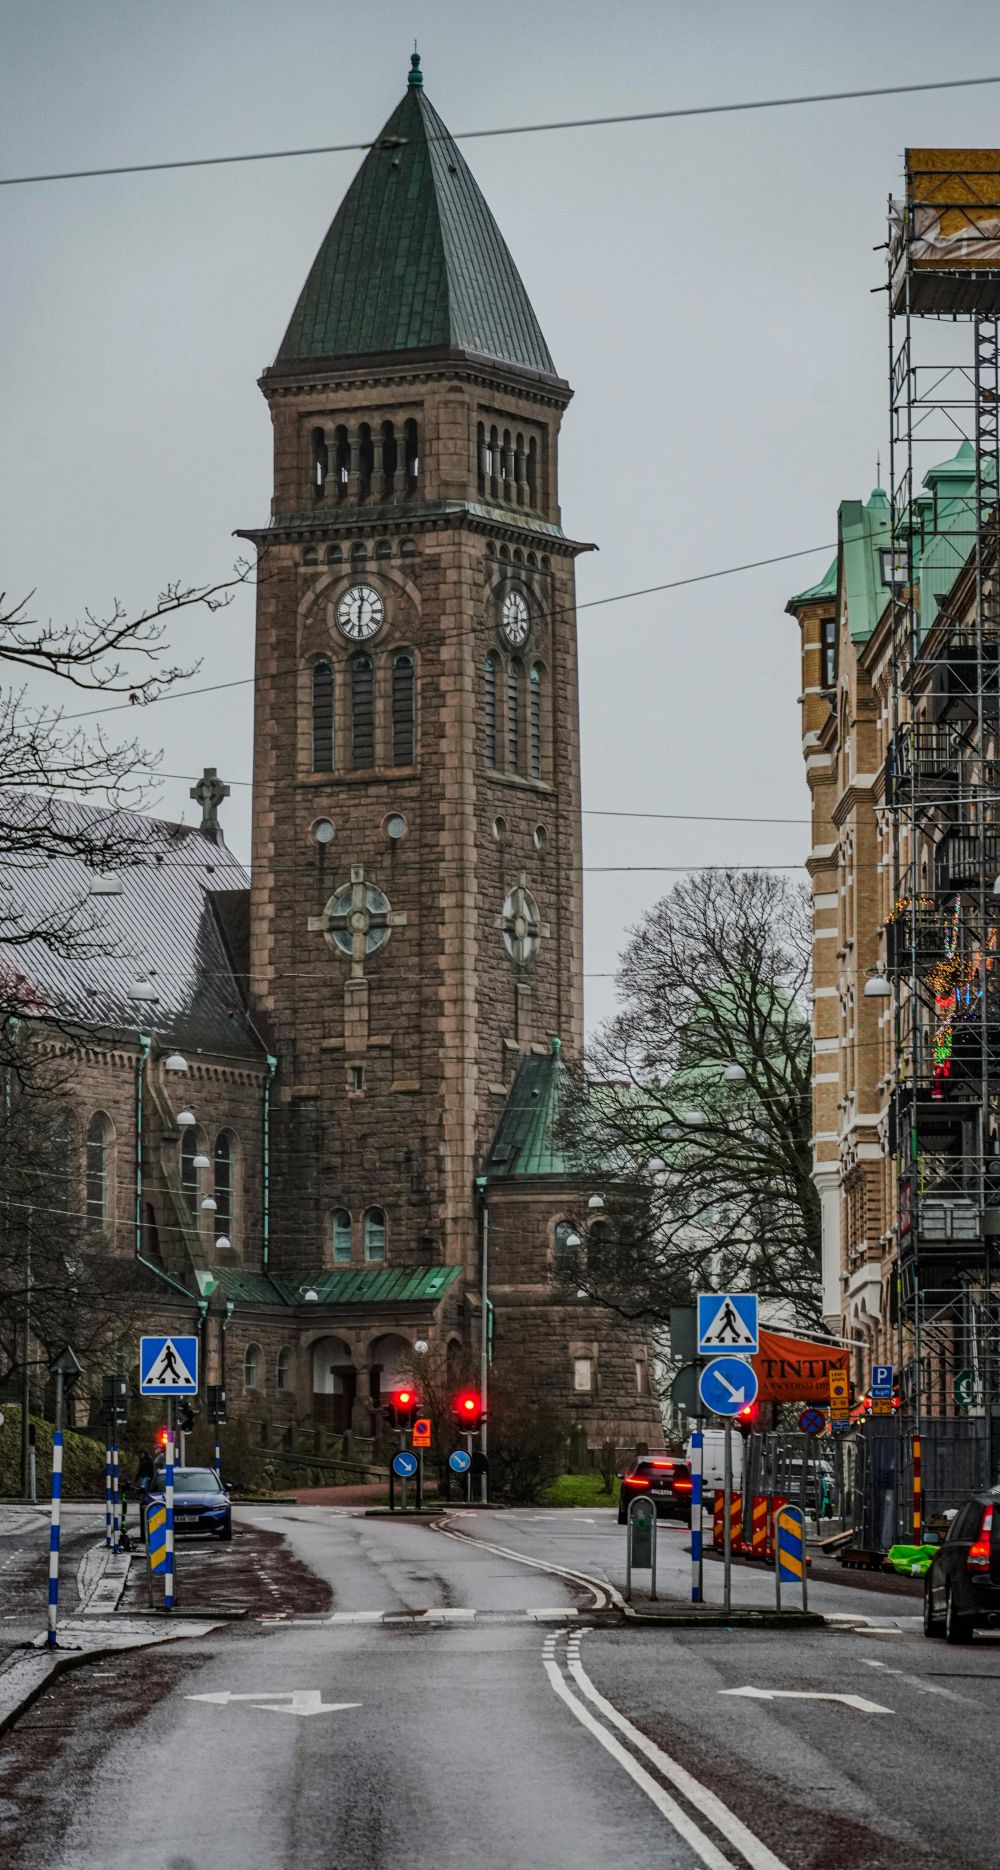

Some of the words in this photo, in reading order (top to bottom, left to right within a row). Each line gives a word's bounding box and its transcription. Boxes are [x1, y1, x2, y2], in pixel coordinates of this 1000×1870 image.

[760, 1358, 844, 1378] TINTIN
[877, 1368, 888, 1384] P
[770, 1382, 813, 1390] SWEDISH
